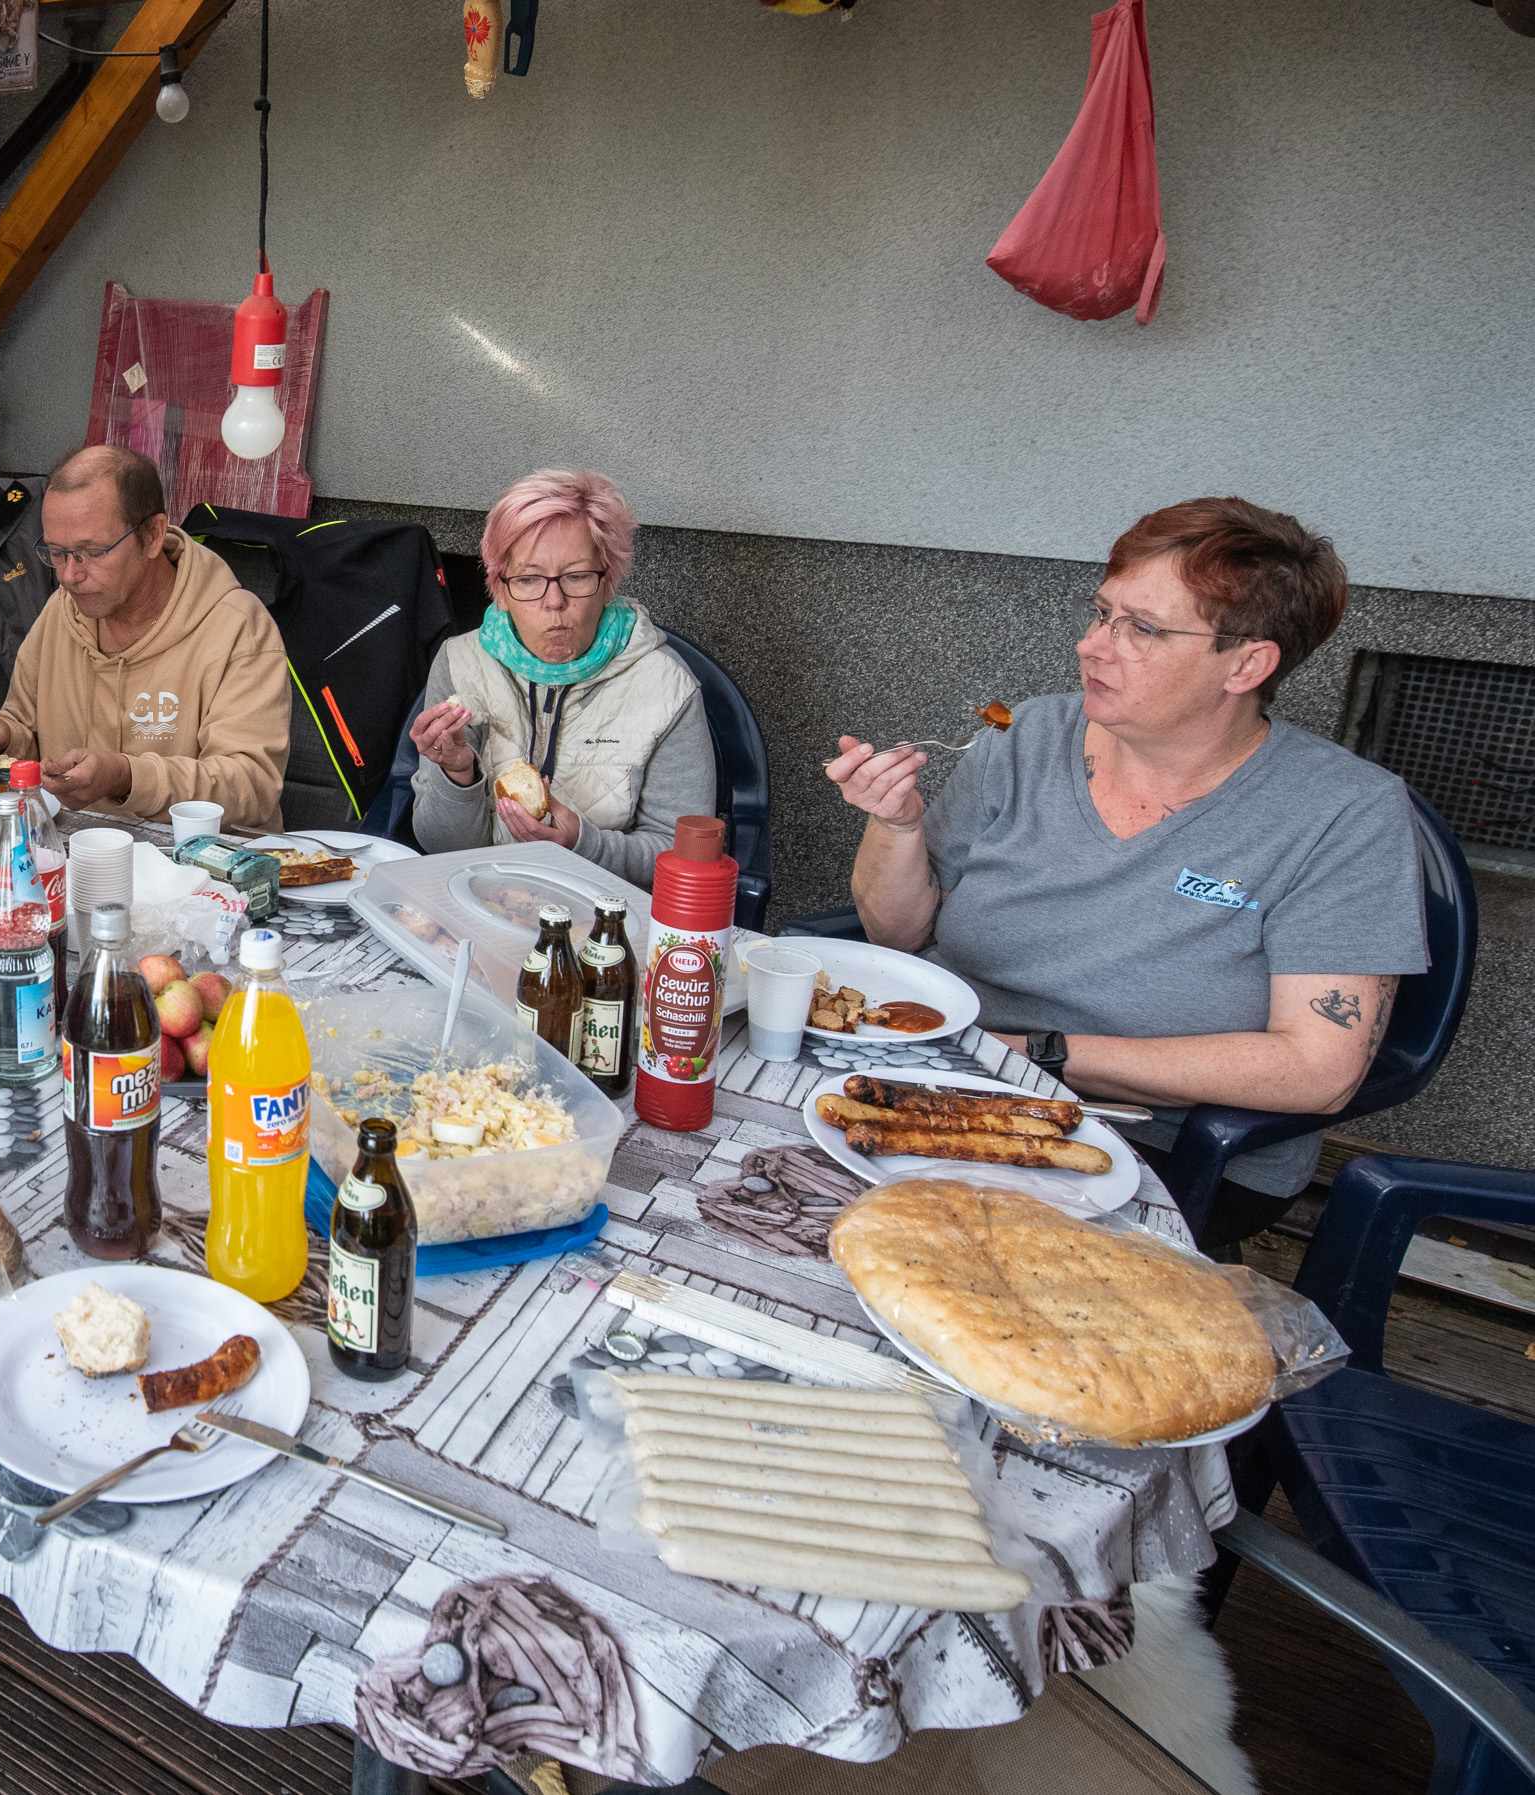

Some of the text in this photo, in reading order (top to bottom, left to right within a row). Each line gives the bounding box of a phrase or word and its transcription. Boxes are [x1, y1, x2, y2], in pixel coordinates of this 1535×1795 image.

[675, 957, 698, 967] HELA
[659, 974, 710, 993] Gewürz
[655, 987, 711, 1007] Ketchup
[655, 1007, 707, 1023] Schaschlik
[668, 1028, 690, 1036] PIKANT
[122, 1079, 158, 1111] mix
[266, 1119, 287, 1129] zero
[767, 1353, 776, 1361] 10
